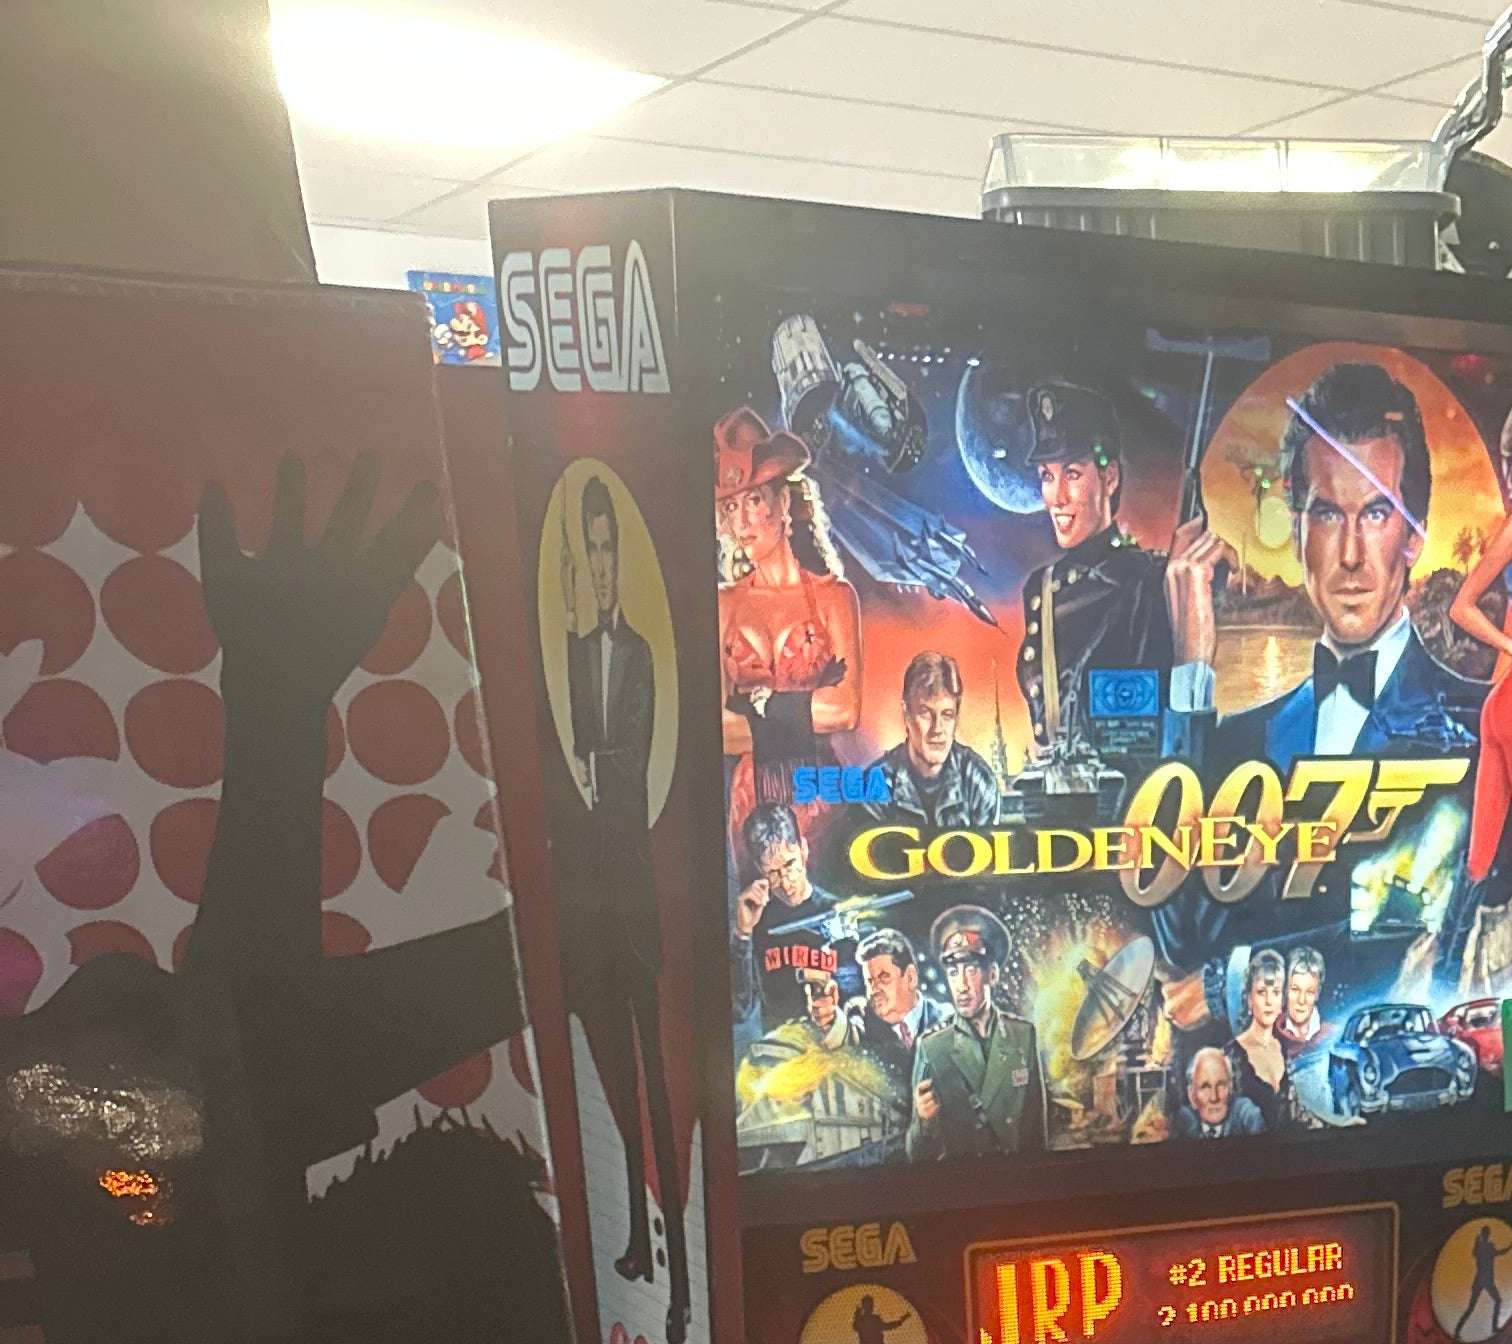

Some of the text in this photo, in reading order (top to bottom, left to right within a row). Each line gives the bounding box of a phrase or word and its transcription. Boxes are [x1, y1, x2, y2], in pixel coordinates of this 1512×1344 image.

[501, 238, 671, 392] SEGA
[792, 766, 894, 805] SEGA
[1119, 758, 1471, 908] 007
[764, 944, 838, 973] WIRED
[800, 1221, 918, 1275] SEGA
[1168, 1257, 1207, 1288] #2
[1217, 1241, 1344, 1284] REGULAR
